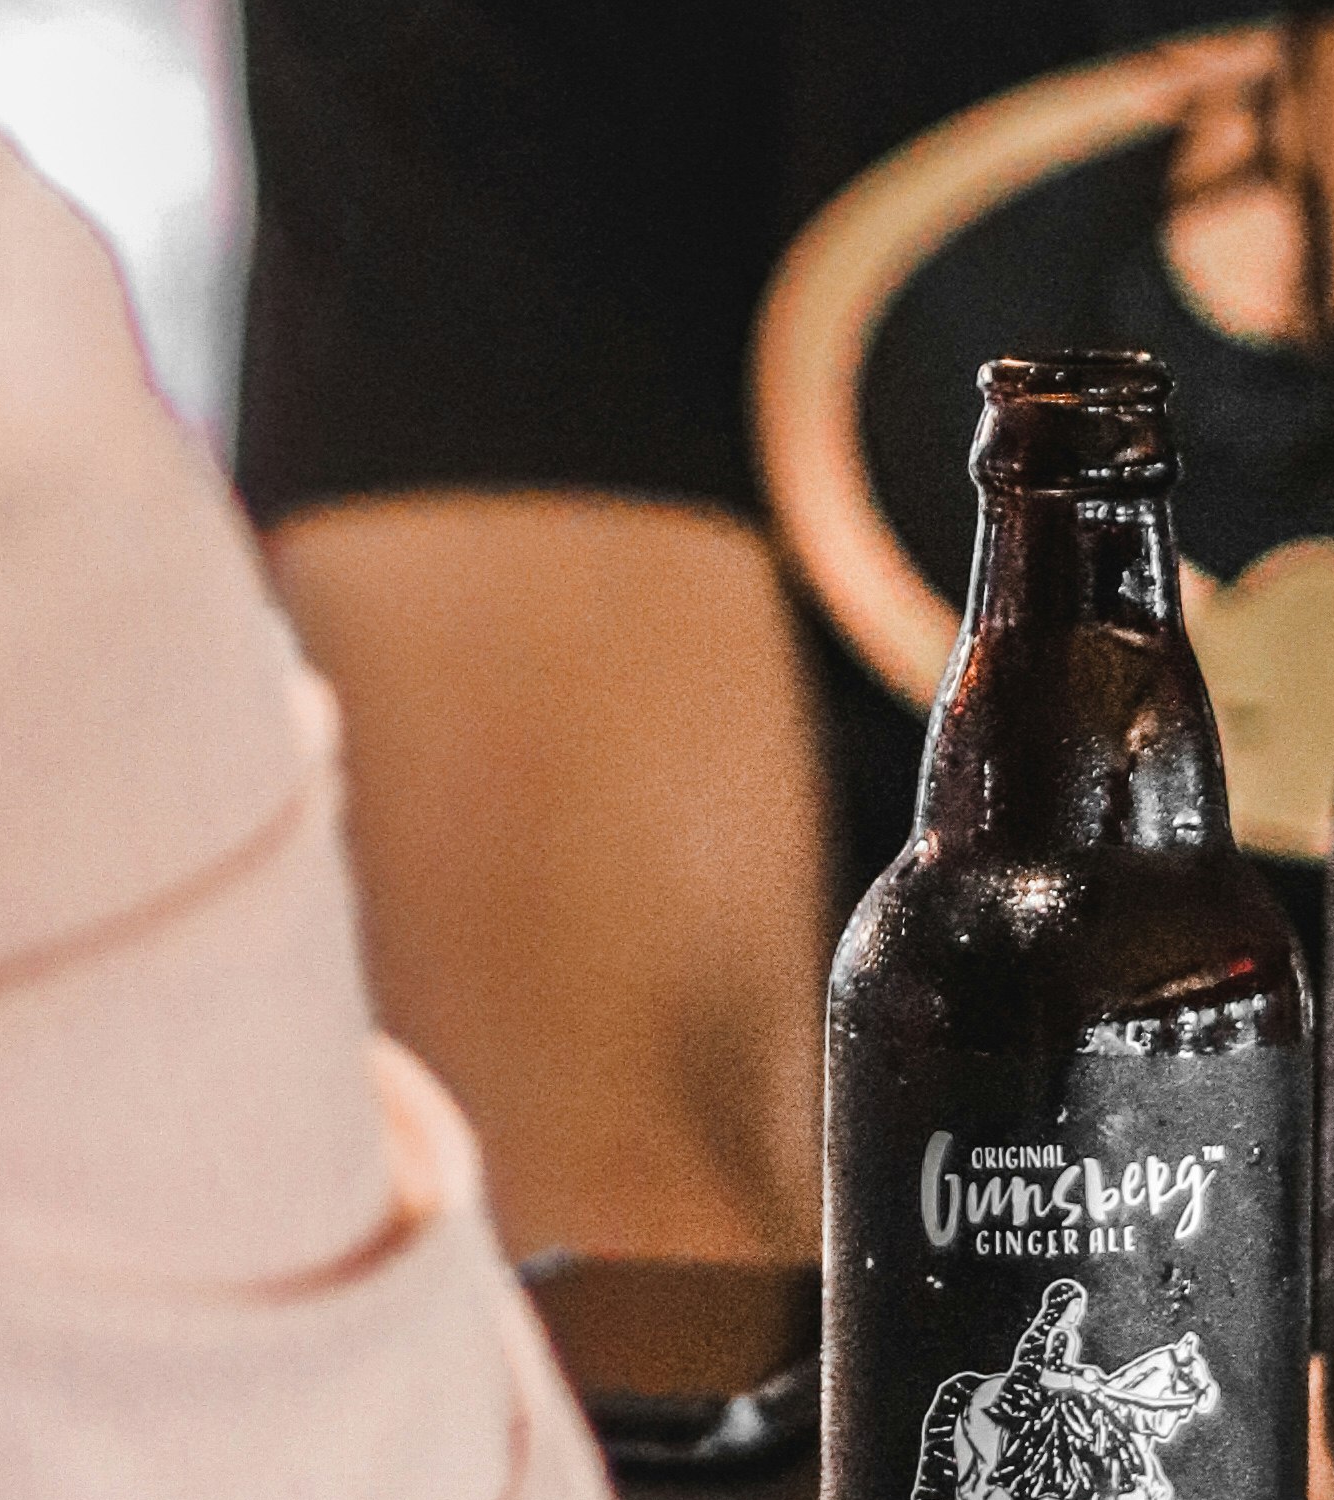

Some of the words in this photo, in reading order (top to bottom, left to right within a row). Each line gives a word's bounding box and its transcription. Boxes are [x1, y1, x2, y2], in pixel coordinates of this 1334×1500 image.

[971, 1145, 1067, 1169] ORIGINAL
[975, 1229, 1079, 1258] GINGER
[1089, 1225, 1136, 1254] ALE
